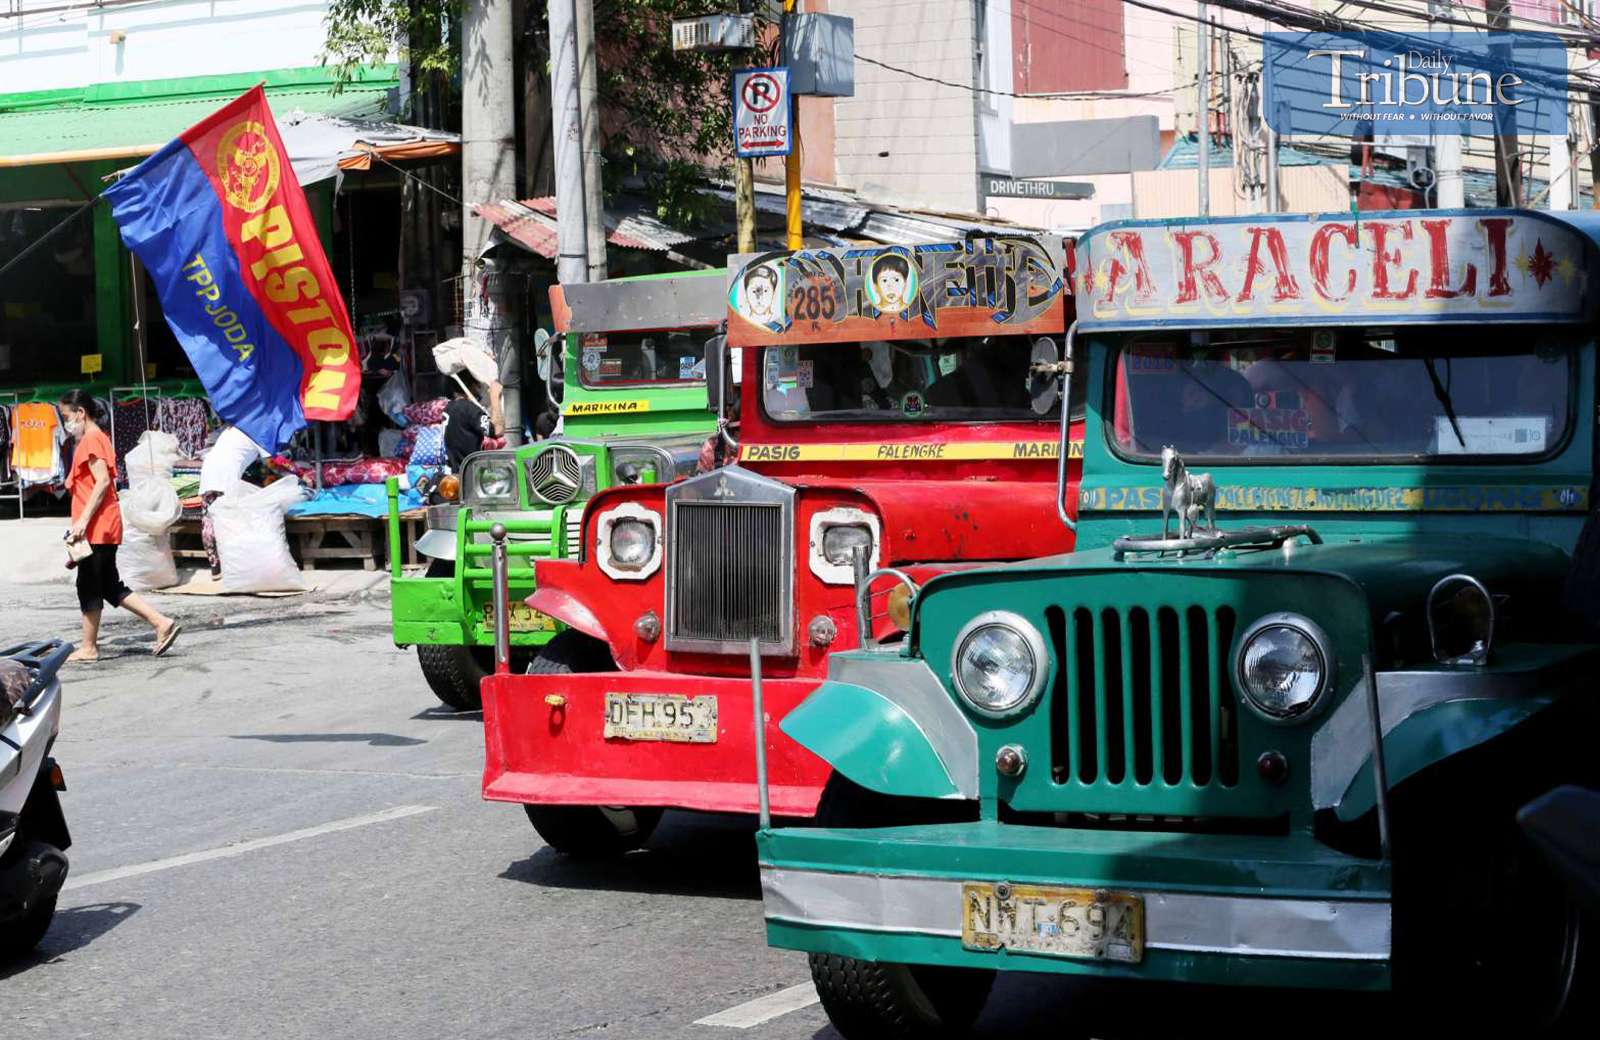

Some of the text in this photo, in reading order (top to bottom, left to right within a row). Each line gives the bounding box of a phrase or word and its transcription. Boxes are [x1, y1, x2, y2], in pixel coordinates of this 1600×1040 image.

[754, 114, 768, 125] NO
[738, 126, 787, 138] PARKING
[990, 180, 1054, 195] DRIVETHRU
[1098, 216, 1515, 308] ARACELI
[241, 204, 350, 411] PISTON
[794, 286, 835, 320] 285
[572, 402, 637, 413] MARIKINA
[747, 446, 801, 460] PASIG
[877, 443, 946, 459] PALENGKE
